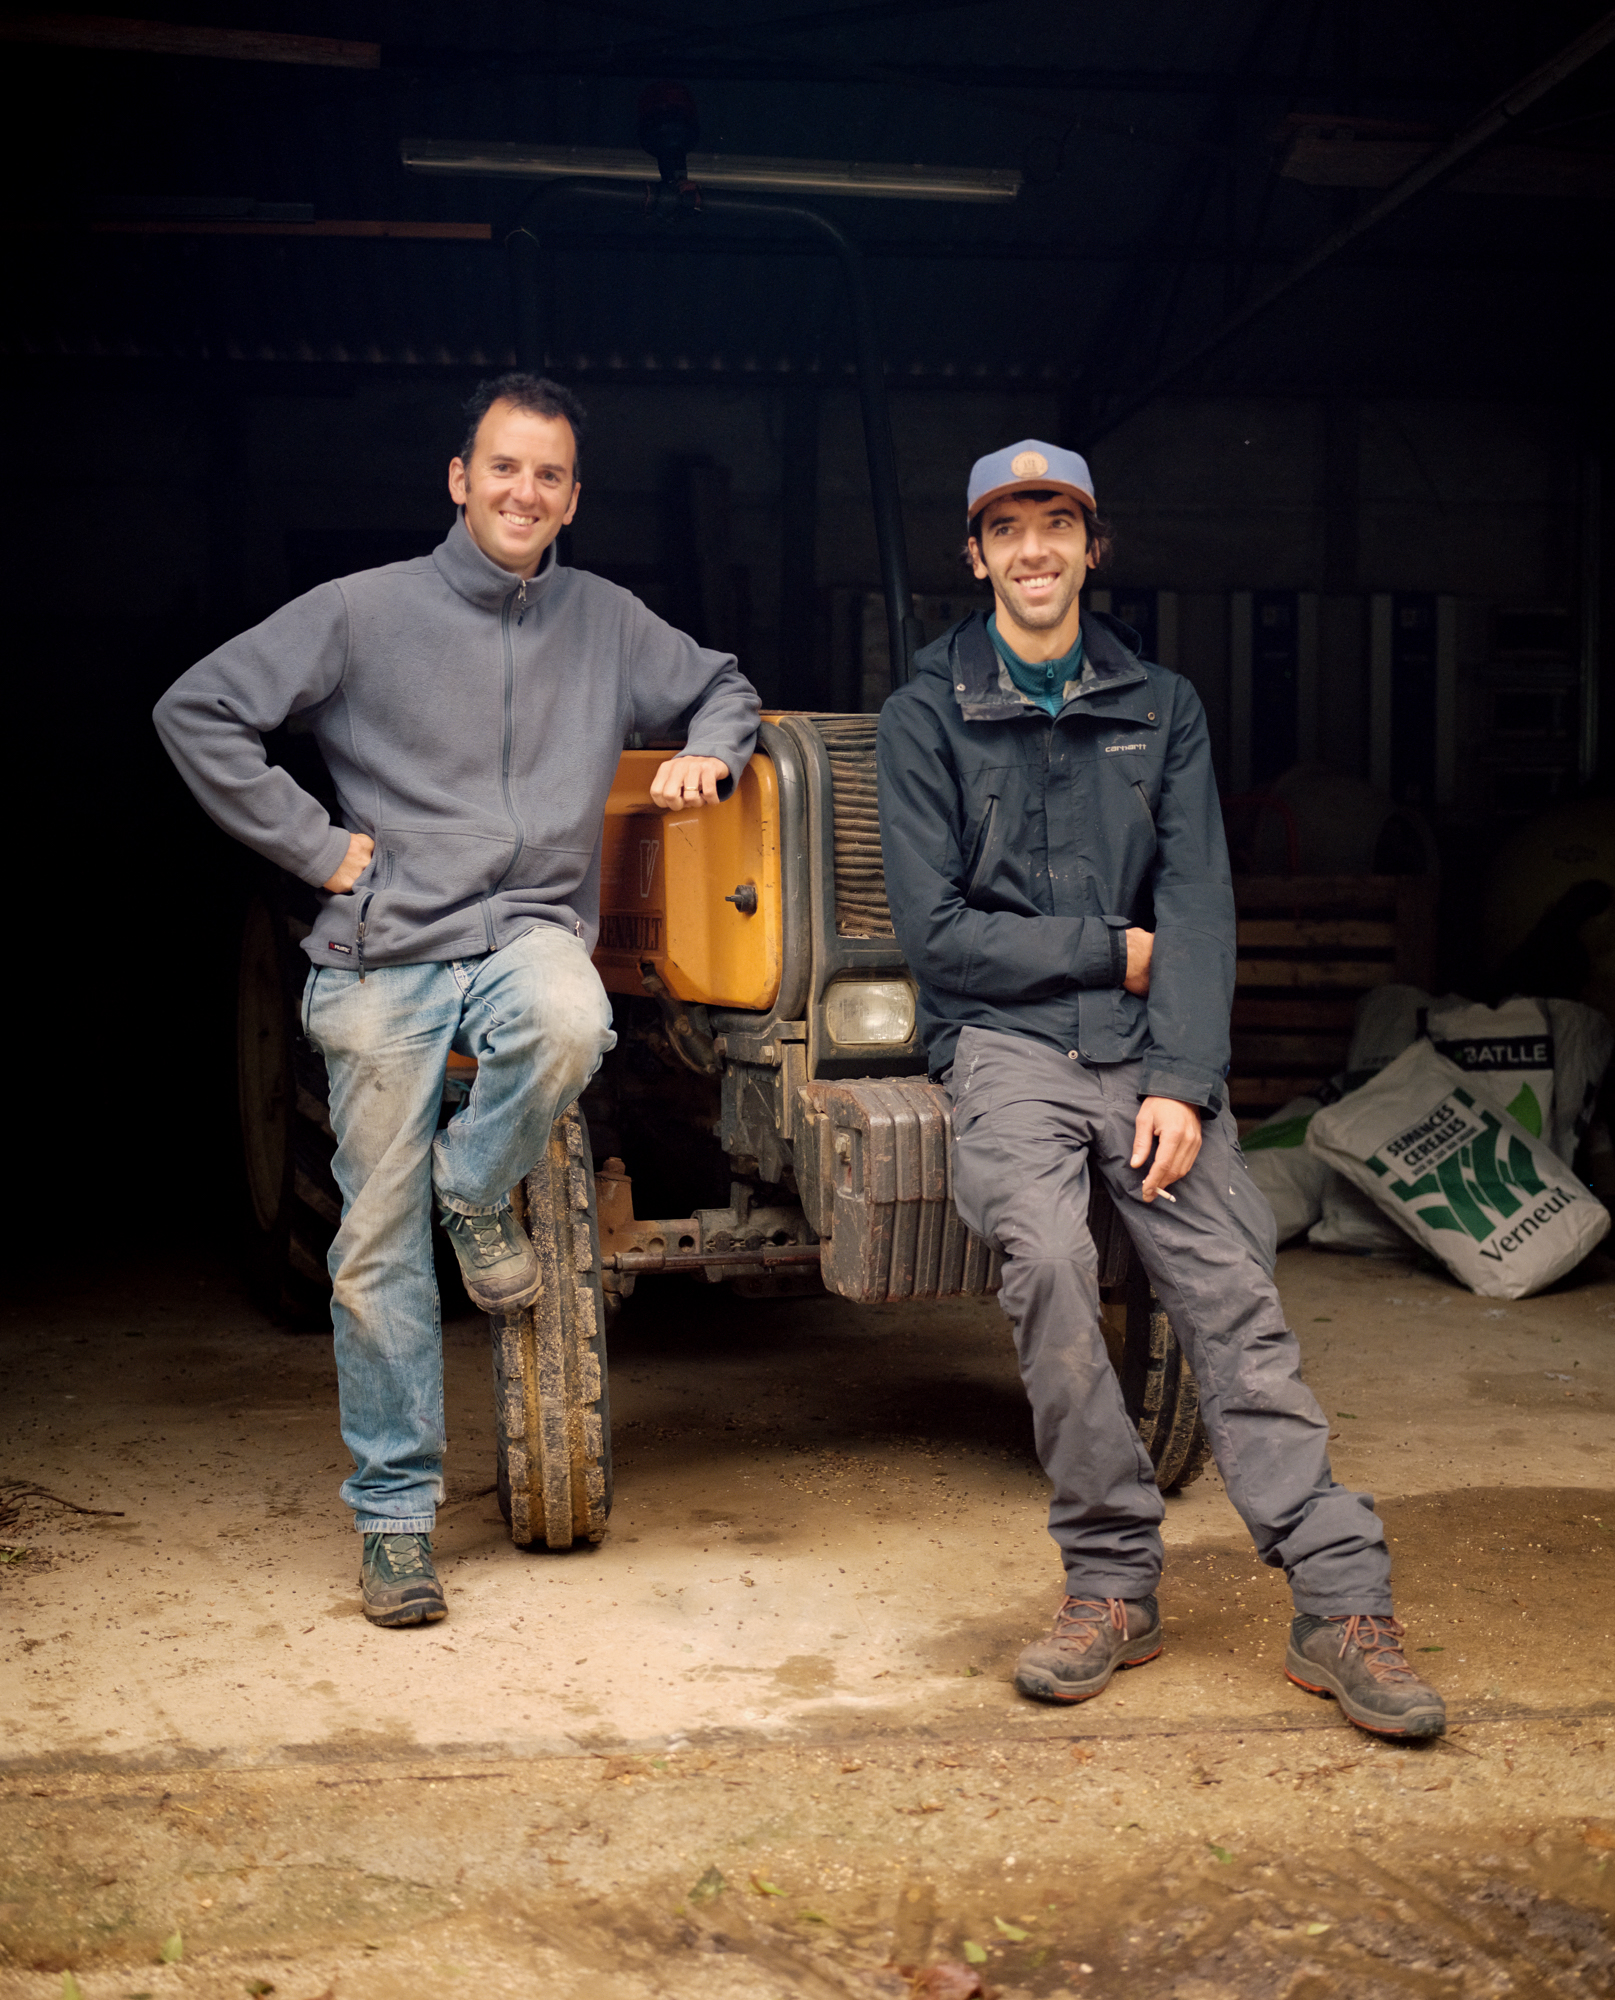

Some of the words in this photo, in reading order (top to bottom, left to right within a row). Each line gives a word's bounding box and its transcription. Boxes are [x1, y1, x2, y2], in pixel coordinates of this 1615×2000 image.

[1105, 743, 1147, 753] carhartt
[1386, 1104, 1455, 1157] SEMENCES
[1403, 1117, 1467, 1166] CEREALES
